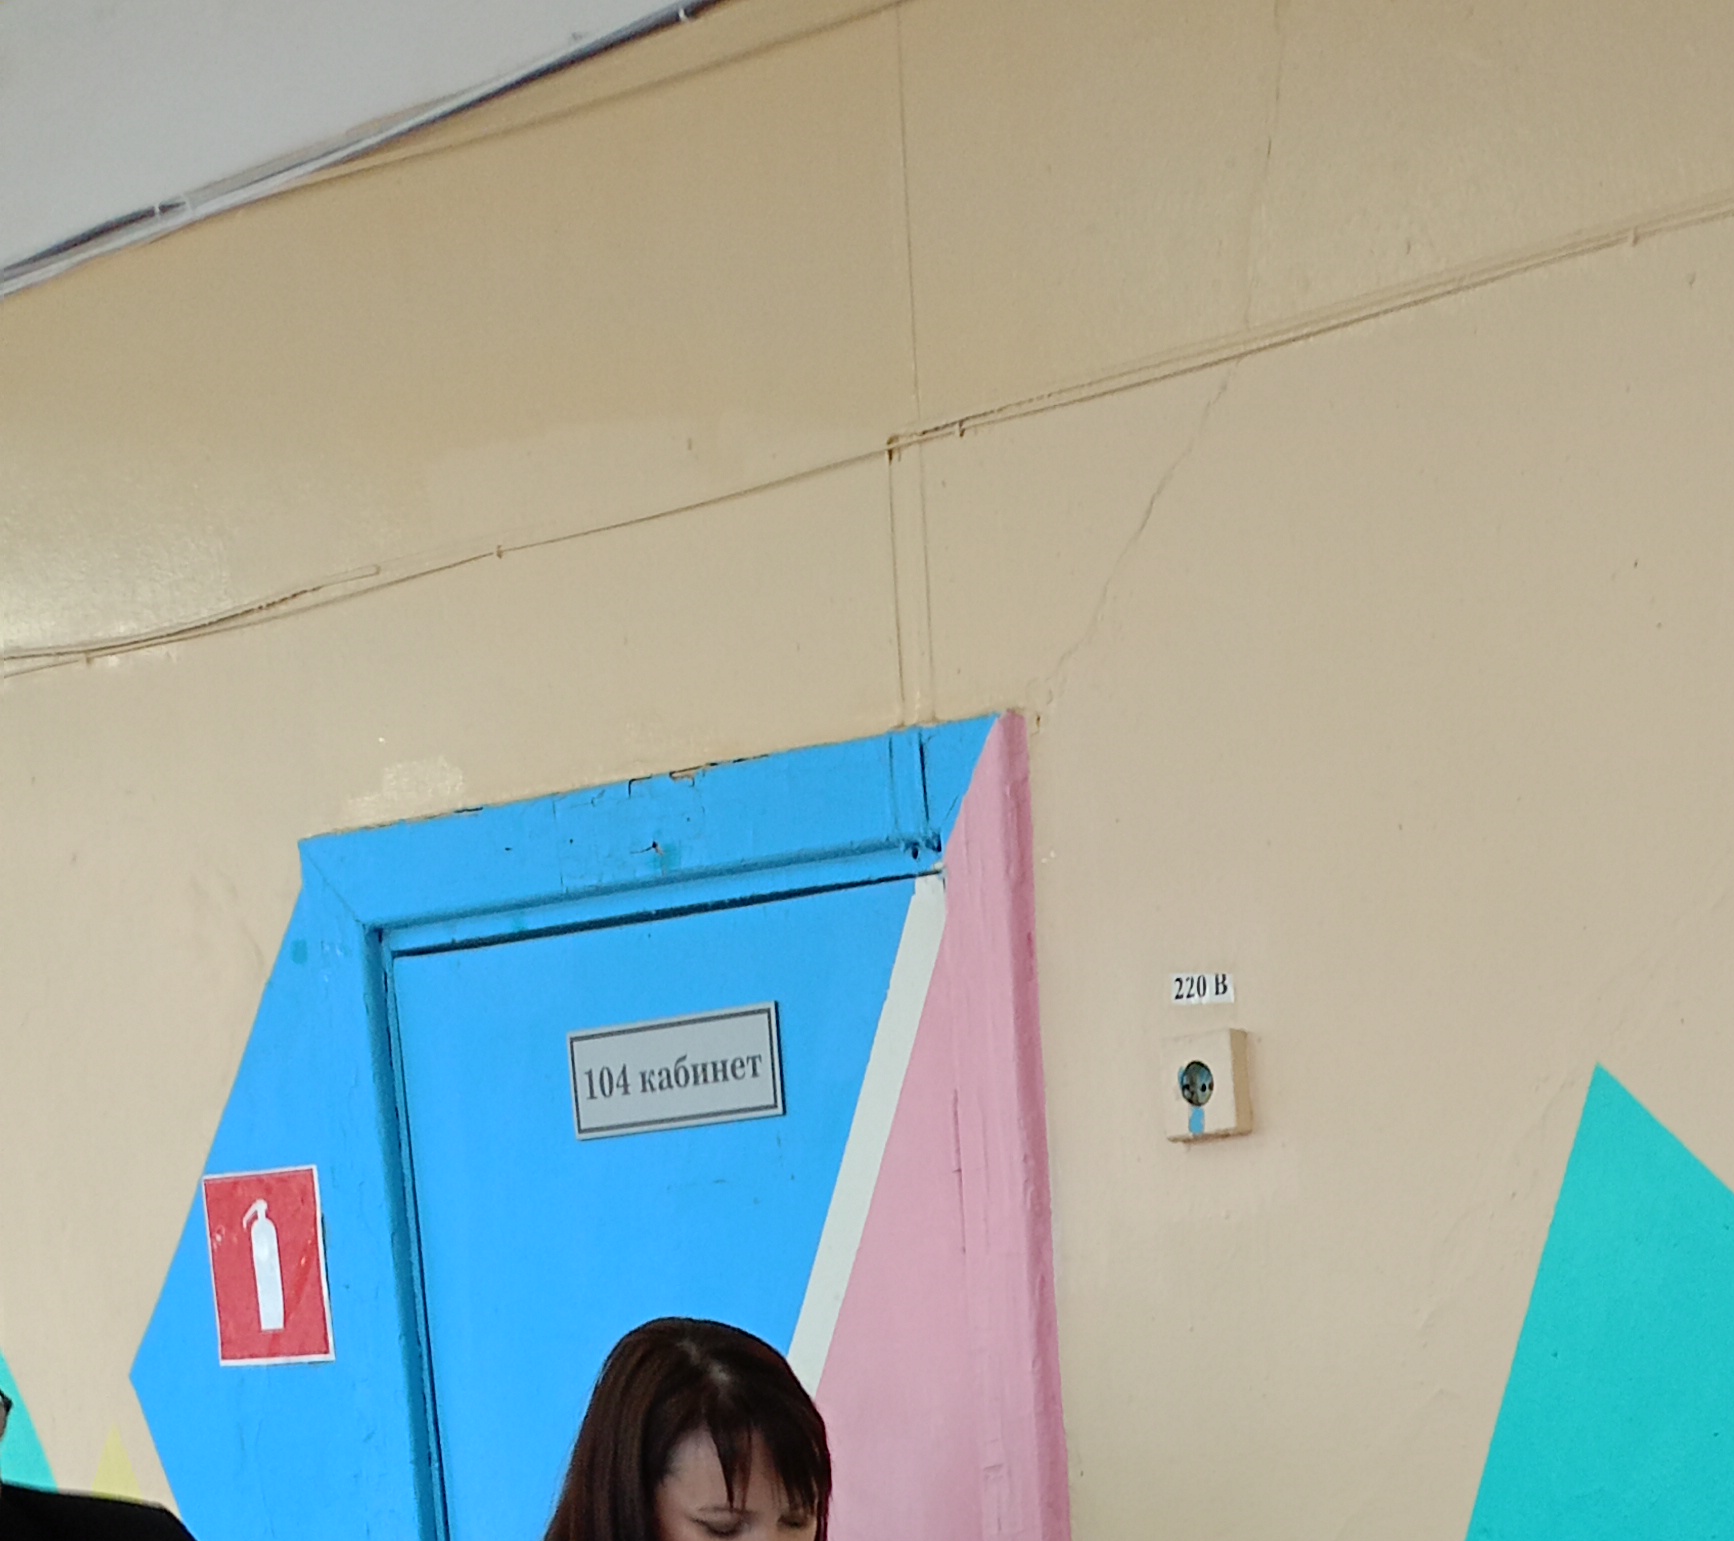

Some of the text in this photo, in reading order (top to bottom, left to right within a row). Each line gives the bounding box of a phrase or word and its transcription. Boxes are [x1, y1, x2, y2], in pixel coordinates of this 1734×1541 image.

[1174, 975, 1207, 1000] 220
[584, 1053, 762, 1101] 104 кабинет
